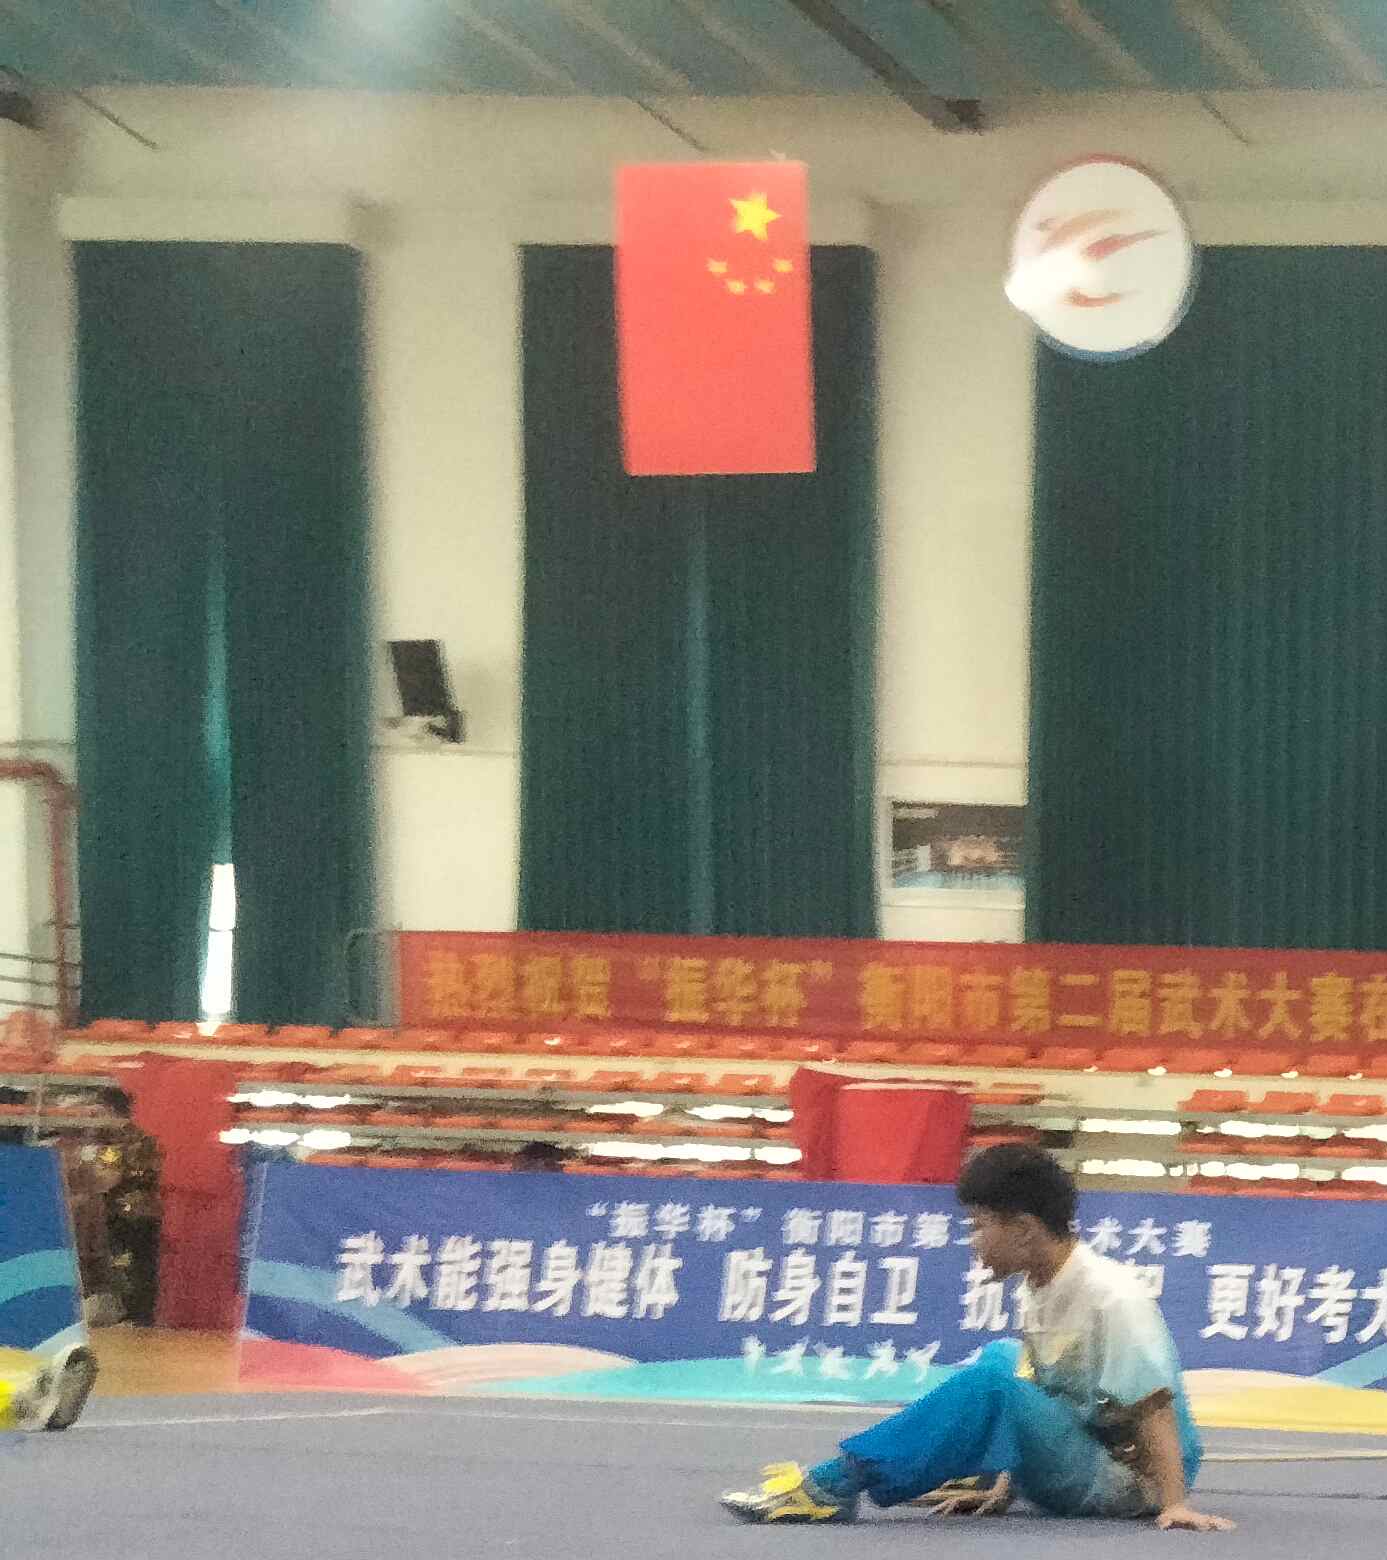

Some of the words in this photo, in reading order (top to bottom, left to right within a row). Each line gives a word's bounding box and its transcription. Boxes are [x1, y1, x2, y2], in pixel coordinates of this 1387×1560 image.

[336, 1231, 685, 1320] 武术能强身健体
[717, 1245, 920, 1328] 防身自卫
